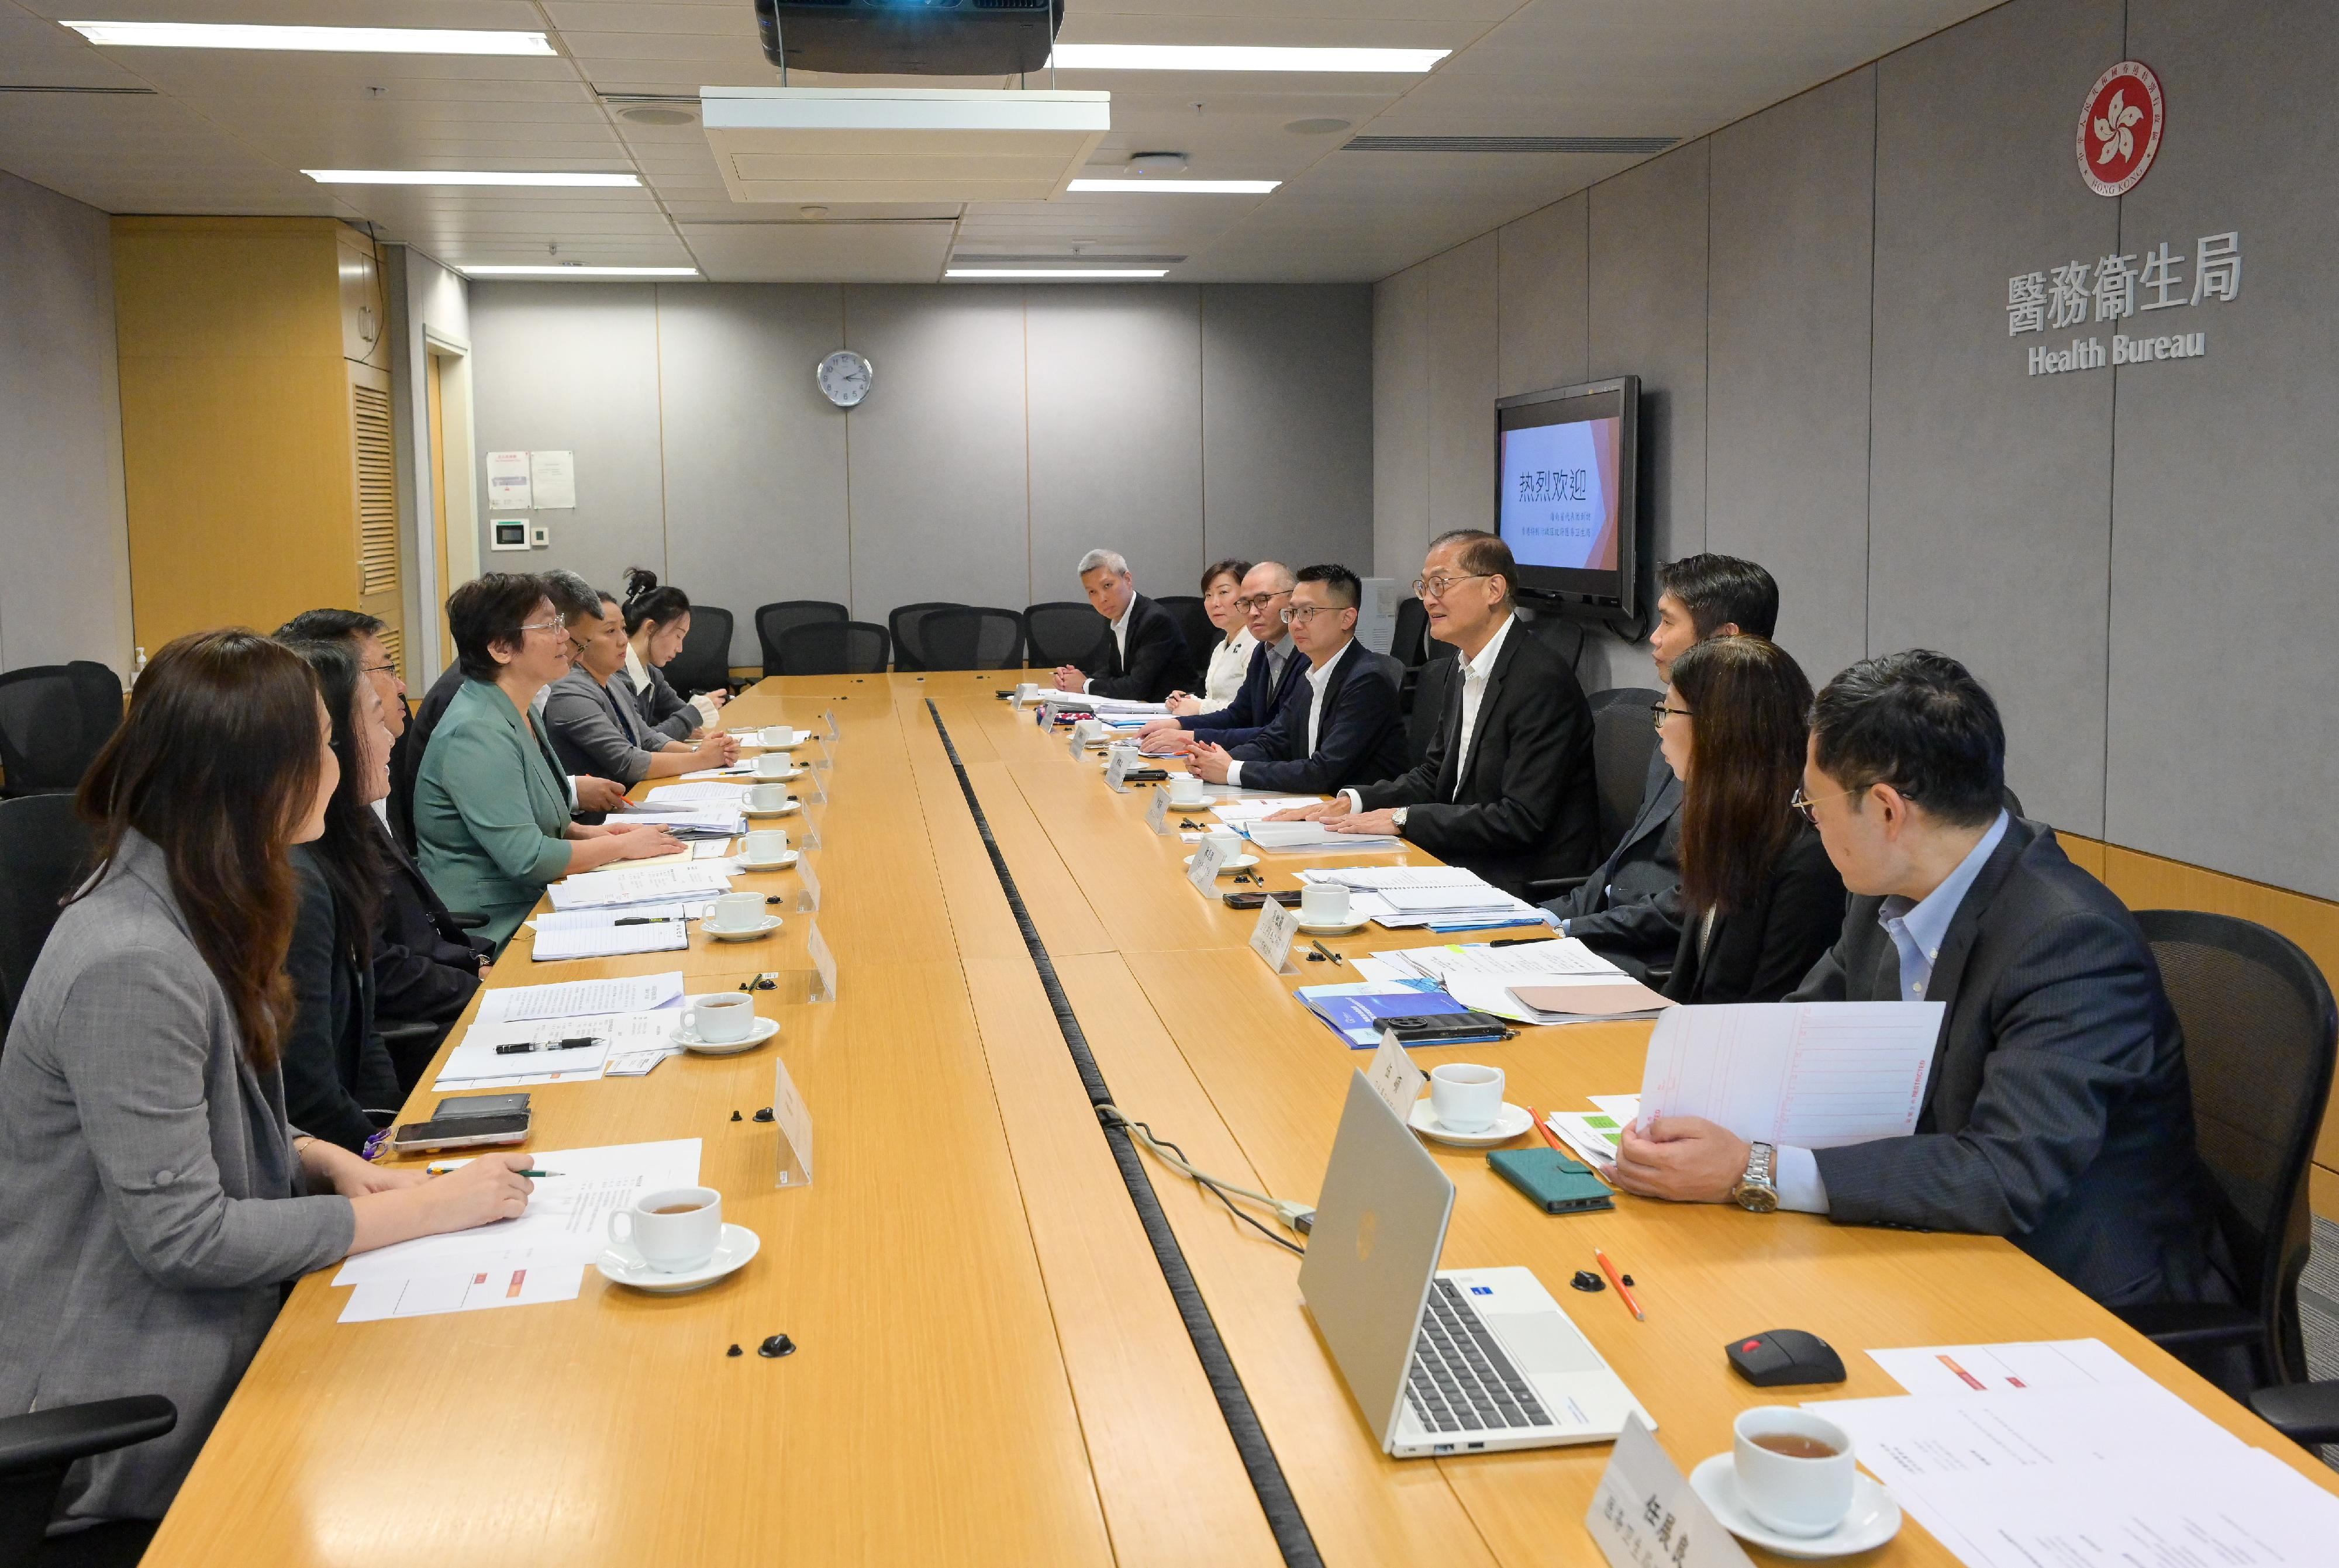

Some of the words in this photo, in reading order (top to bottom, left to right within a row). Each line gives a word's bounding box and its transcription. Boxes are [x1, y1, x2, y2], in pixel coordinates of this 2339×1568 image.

[2091, 178, 2115, 194] HONG
[2118, 166, 2143, 193] KONG
[2028, 337, 2106, 375] Health
[2112, 332, 2205, 365] Bureau
[1519, 468, 1586, 502] 热烈欢迎
